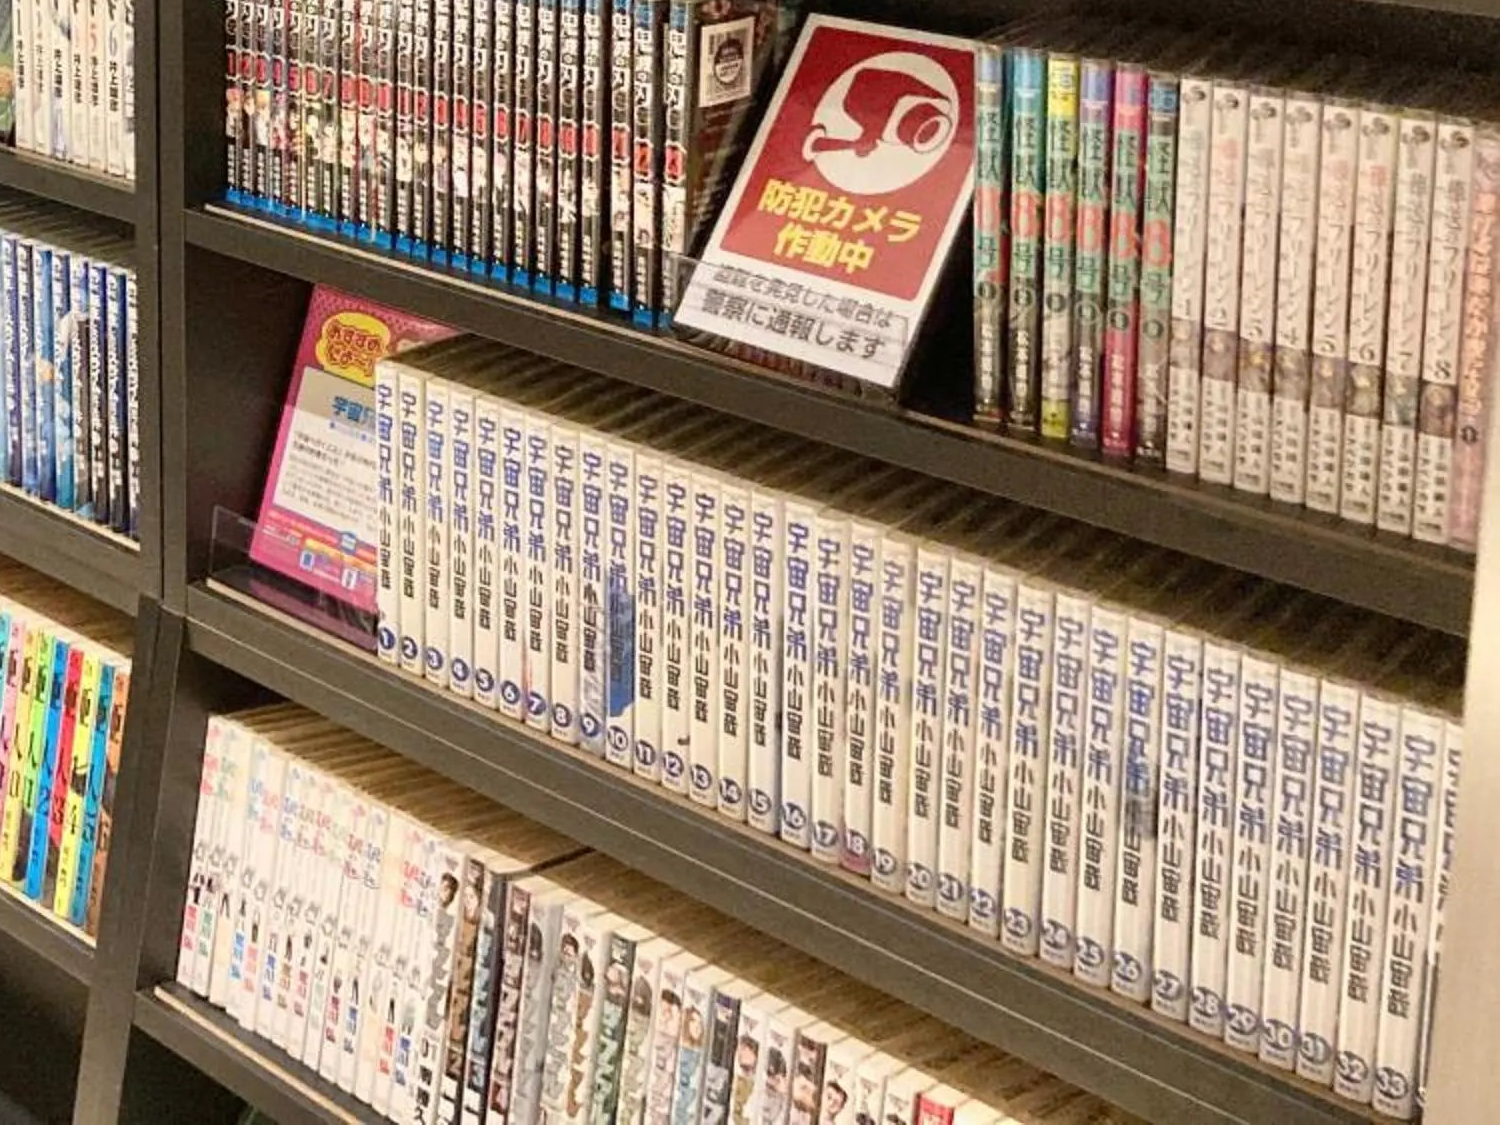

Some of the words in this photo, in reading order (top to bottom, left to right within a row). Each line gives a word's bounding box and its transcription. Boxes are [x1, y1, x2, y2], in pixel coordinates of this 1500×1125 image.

[758, 178, 923, 242] 防犯カメラ
[773, 223, 876, 274] 作動中
[701, 287, 885, 359] 警察に通報します
[378, 384, 392, 505] 宇宙兄弟
[402, 392, 416, 513] 宇宙兄弟
[428, 401, 443, 523] 宇宙兄弟
[453, 409, 469, 534] 宇宙兄弟
[478, 417, 495, 543] 宇宙兄弟
[503, 427, 521, 553] 宇宙兄弟
[528, 436, 546, 563] 宇宙兄弟
[554, 445, 573, 574] 宇宙兄弟
[583, 452, 601, 583] 宇宙兄弟
[609, 462, 628, 595] 宇宙兄弟
[639, 475, 658, 607] 宇宙兄弟
[667, 482, 686, 618] 宇宙兄弟
[694, 492, 715, 629] 宇宙兄弟
[724, 504, 745, 642] 宇宙兄弟
[753, 512, 772, 650] 宇宙兄弟
[787, 523, 809, 663] 宇宙兄弟
[817, 538, 840, 679] 宇宙兄弟
[851, 544, 874, 687] 宇宙兄弟
[880, 561, 904, 704] 宇宙兄弟
[916, 571, 942, 717] 宇宙兄弟
[949, 580, 975, 727] 宇宙兄弟
[981, 592, 1007, 741] 宇宙兄弟
[1015, 608, 1044, 759] 宇宙兄弟
[1053, 618, 1083, 769] 宇宙兄弟
[1088, 629, 1118, 786] 宇宙兄弟
[608, 728, 628, 749] 10
[636, 742, 655, 763] 11
[720, 780, 741, 801] 14
[1163, 655, 1194, 813] 宇宙兄弟
[1203, 668, 1234, 827] 宇宙兄弟
[1239, 683, 1272, 844] 宇宙兄弟
[1277, 695, 1312, 859] 宇宙兄弟
[1315, 705, 1350, 870] 宇宙兄弟
[750, 791, 771, 813] 15
[783, 805, 806, 826] 16
[814, 823, 838, 844] 17
[845, 832, 868, 854] 18
[873, 850, 896, 872] 19
[1355, 722, 1392, 888] 宇宙兄弟
[1395, 735, 1436, 903] 宇宙兄弟
[908, 865, 932, 888] 20
[938, 876, 962, 899] 21
[1113, 955, 1142, 980] 26
[1192, 989, 1221, 1014] 28
[1264, 1022, 1295, 1048] 30
[1301, 1035, 1332, 1061] 31
[1337, 1054, 1368, 1080] 32
[1377, 1070, 1408, 1096] 33
